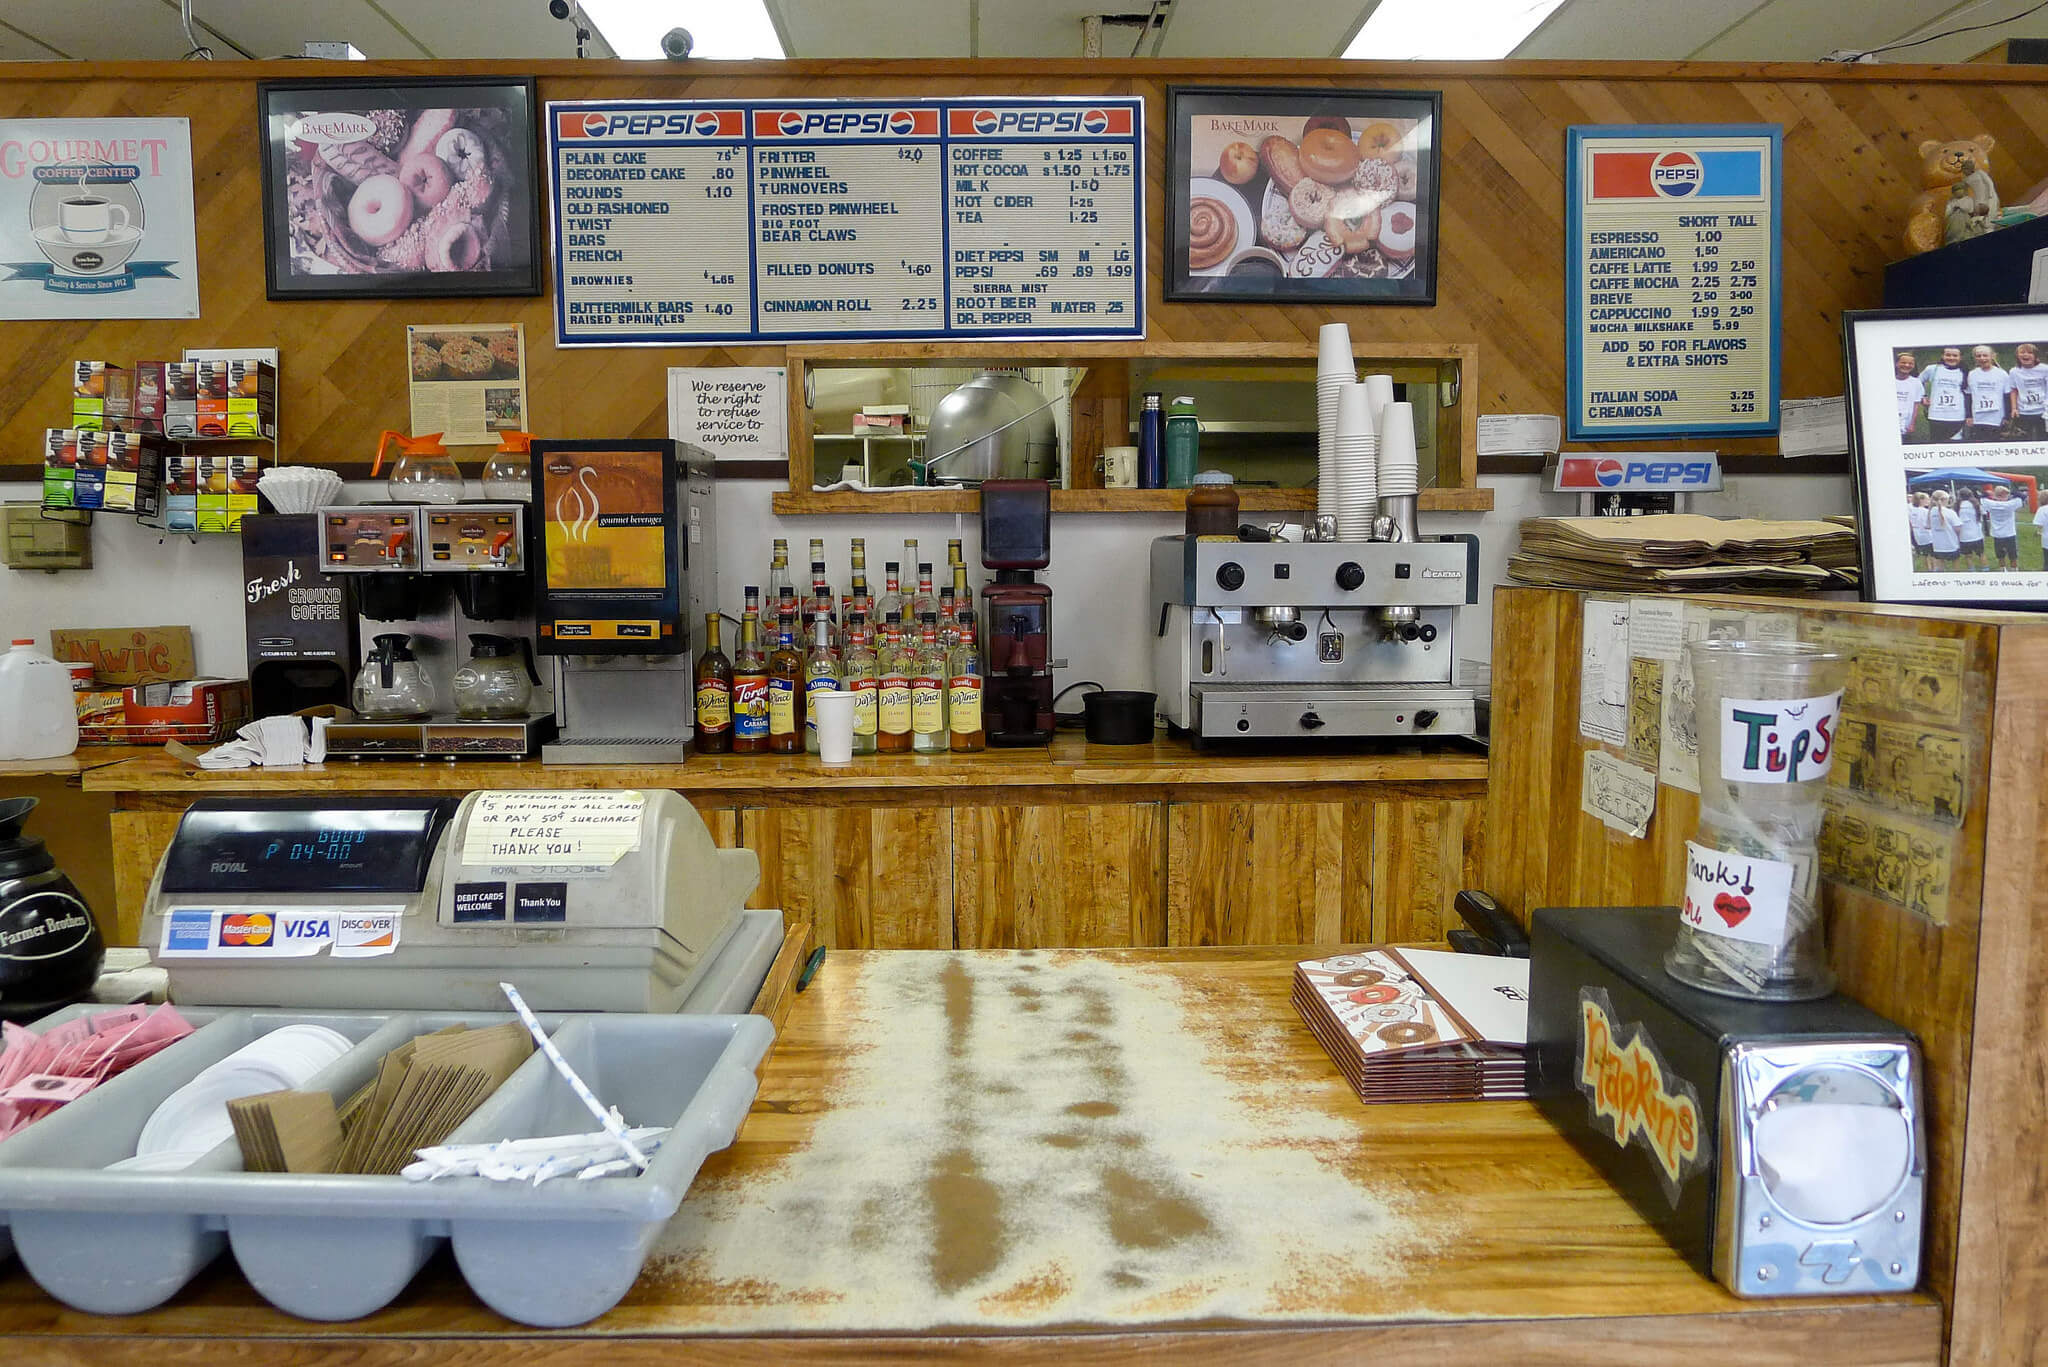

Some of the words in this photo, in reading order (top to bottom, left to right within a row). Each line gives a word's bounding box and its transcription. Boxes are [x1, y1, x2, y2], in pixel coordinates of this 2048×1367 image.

[608, 115, 693, 135] PEPSI
[804, 114, 889, 133] PEPSI
[999, 112, 1083, 132] PEPSI
[0, 139, 167, 179] GOURMET
[566, 153, 605, 164] PLAIN
[613, 153, 646, 164] CAKE
[760, 152, 816, 163] FRITTER
[953, 149, 1002, 160] COFFEE
[1058, 149, 1082, 160] 1.25
[37, 168, 84, 178] COFFEE
[88, 168, 136, 177] CENTER
[567, 168, 646, 180] DECORATED
[651, 168, 685, 180] CAKE
[712, 168, 734, 180] .80
[760, 167, 830, 178] PINWHEEL
[954, 164, 980, 176] HOT
[983, 164, 1028, 176] COCOA
[1053, 165, 1081, 176] 1.50
[1104, 164, 1130, 176] 1.75
[1655, 169, 1699, 180] PEPSI
[567, 187, 622, 198] ROUNDS
[705, 186, 732, 198] 1.10
[760, 183, 848, 194] TURNOVERS
[956, 180, 989, 192] MILK
[955, 196, 982, 207] HOT
[994, 196, 1033, 207] CIDER
[568, 203, 592, 214] OLD
[598, 202, 669, 214] FASHIONED
[762, 204, 824, 215] FROSTED
[829, 203, 898, 215] PINWHEEL
[957, 212, 983, 223] TEA
[1679, 216, 1719, 227] SHORT
[1728, 216, 1757, 227] TALL
[568, 219, 612, 230] TWIST
[763, 220, 783, 229] BIG
[790, 220, 819, 228] FOOT
[569, 235, 605, 246] BARS
[763, 230, 801, 242] BEAR
[809, 229, 856, 241] CLAWS
[1590, 232, 1659, 244] ESPRESSO
[1695, 231, 1722, 242] 1.00
[569, 250, 622, 261] FRENCH
[955, 250, 985, 262] DIET
[989, 250, 1024, 261] PEPSI
[1039, 250, 1058, 261] SM
[1080, 250, 1089, 261] M
[1114, 250, 1129, 261] LG
[1590, 247, 1665, 259] AMERICANO
[1695, 246, 1718, 258] 1.50
[767, 264, 812, 275] FILLED
[819, 263, 874, 275] DONUTS
[956, 266, 993, 277] PEPSI
[1036, 266, 1058, 277] .69
[1072, 266, 1093, 277] .89
[1106, 265, 1132, 277] 1.99
[1590, 262, 1629, 274] CAFFE
[1634, 262, 1671, 273] LATTE
[1692, 261, 1718, 272] 1.99
[1730, 261, 1755, 272] 2.50
[571, 276, 633, 285] BROWNIES
[1590, 278, 1629, 290] CAFFE
[1634, 277, 1679, 289] MOCHA
[1692, 276, 1720, 287] 2.25
[1730, 276, 1757, 287] 2.75
[973, 284, 1012, 293] SIERRA
[1022, 284, 1048, 293] MIST
[957, 297, 995, 309] ROOT
[1000, 297, 1036, 308] BEER
[1590, 293, 1632, 305] BREVE
[1692, 291, 1717, 303] 2.50
[570, 302, 652, 313] BUTTERMILK
[658, 302, 693, 313] BARS
[764, 300, 833, 312] CINNAMON
[838, 300, 871, 311] ROLL
[902, 299, 937, 310] 2.25
[1051, 302, 1096, 313] WATER
[957, 312, 978, 324] DR.
[983, 312, 1032, 324] PEPPER
[1590, 307, 1671, 320] CAPPUCCINO
[1692, 307, 1719, 318] 1.99
[1730, 306, 1753, 317] 2.50
[571, 316, 612, 324] RAISED
[618, 315, 685, 326] SPRINKLES
[1590, 322, 1628, 332] MOCHA
[1635, 321, 1694, 332] MILKSHAKE
[1713, 320, 1739, 330] 5.99
[1602, 340, 1629, 353] ADD
[1639, 340, 1655, 352] 50
[1662, 339, 1686, 351] FOR
[1693, 338, 1747, 351] FLAVORS
[1638, 355, 1679, 367] EXTRA
[1685, 354, 1728, 366] SHOTS
[692, 381, 713, 391] We
[716, 383, 766, 392] reserve
[696, 393, 722, 404] the
[724, 392, 762, 408] right
[1590, 392, 1638, 403] ITALIAN
[1644, 390, 1678, 402] SODA
[1730, 391, 1754, 400] 3.25
[698, 407, 715, 416] to
[717, 406, 761, 419] refuse
[1588, 406, 1663, 418] CREAMOSA
[1731, 404, 1754, 412] 3.25
[696, 419, 745, 430] service
[745, 419, 764, 429] to
[702, 433, 759, 445] anyone.
[1904, 452, 1934, 460] DONUT
[1623, 462, 1712, 484] PEPSI
[600, 515, 628, 526] gourmet
[630, 513, 661, 525] beverages
[247, 561, 302, 603] Fresh
[289, 588, 342, 603] GROUND
[291, 605, 340, 620] COFFEE
[810, 681, 836, 689] Almond
[1733, 708, 1832, 782] Tips
[505, 815, 531, 823] PAY
[510, 828, 562, 838] PLEASE
[492, 844, 539, 855] THANK
[210, 863, 249, 873] ROYAL
[491, 867, 518, 875] ROYAL
[457, 894, 477, 902] DEBIT
[479, 892, 504, 901] CARDS
[520, 898, 545, 907] Thank
[546, 898, 561, 907] You
[457, 902, 492, 911] WELCOME
[0, 924, 46, 947] Farmer
[45, 913, 86, 932] Brothers
[222, 924, 273, 934] MasterCard
[284, 920, 331, 938] VISA
[341, 920, 390, 929] DISCOVER
